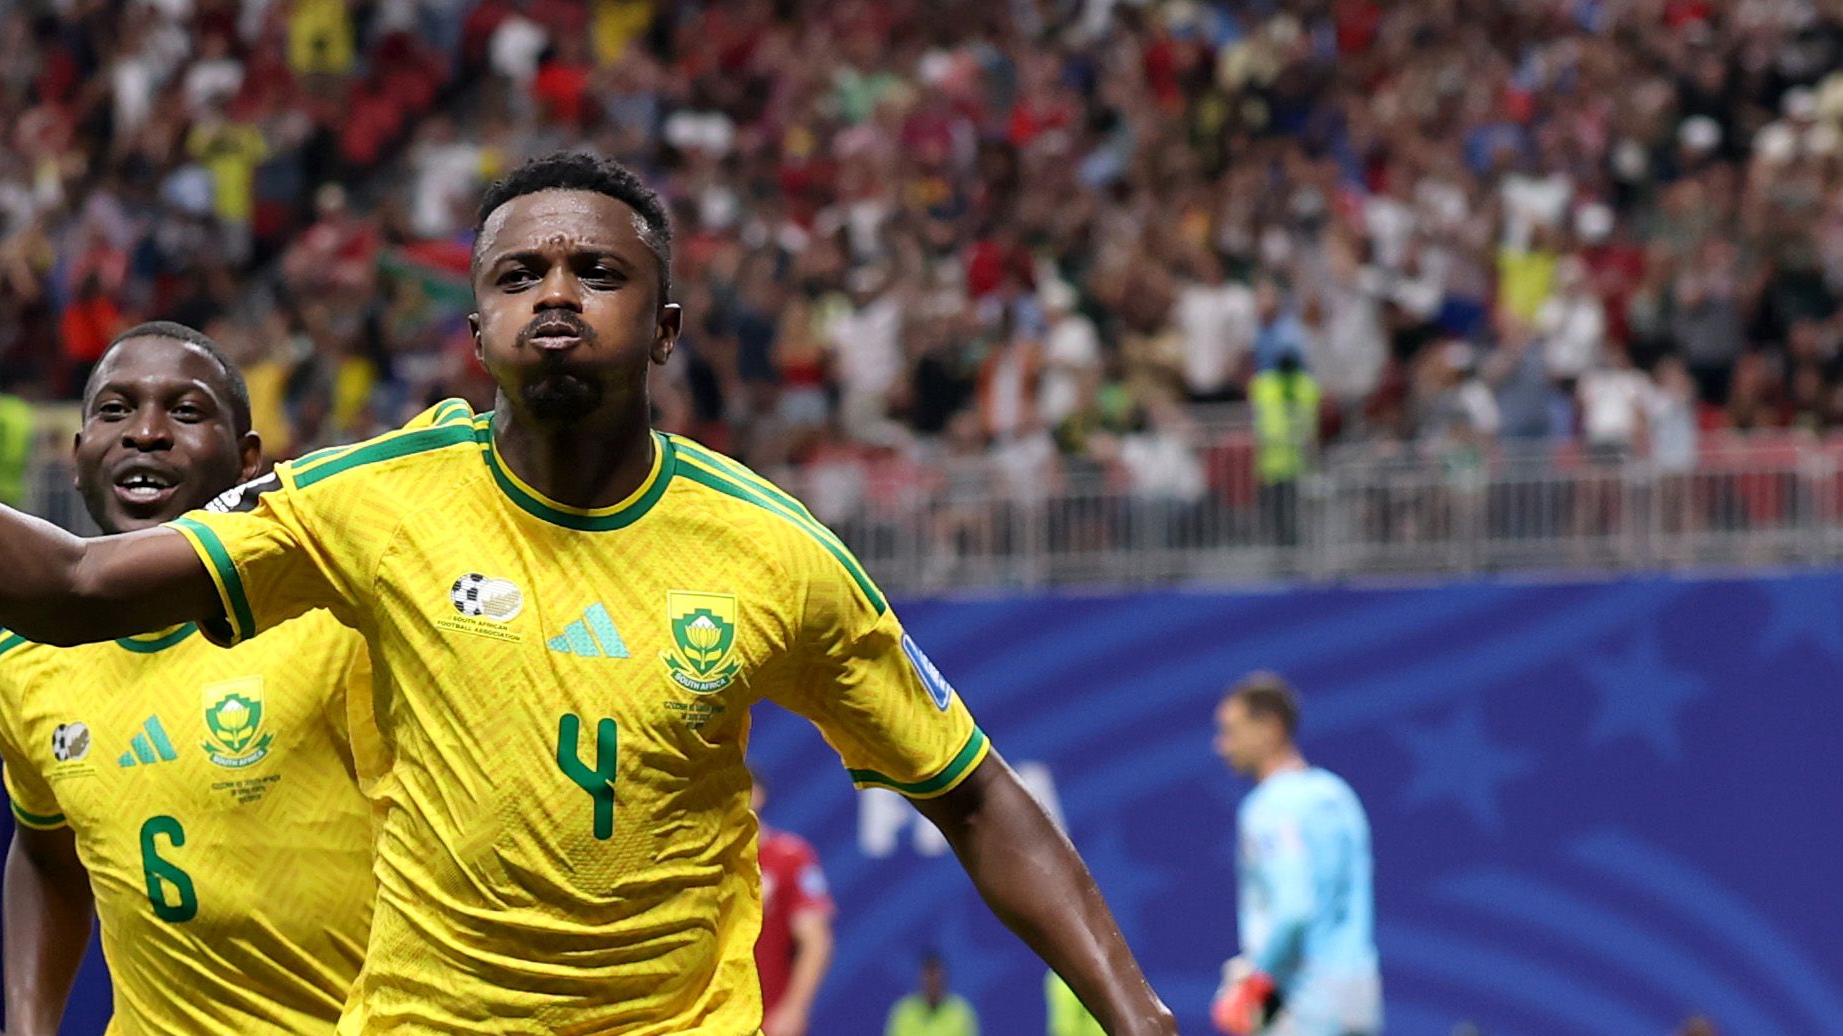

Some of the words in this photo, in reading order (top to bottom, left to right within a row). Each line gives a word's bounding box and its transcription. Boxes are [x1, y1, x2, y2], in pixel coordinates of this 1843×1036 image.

[437, 620, 471, 631] FOOTBALL
[474, 627, 521, 641] ASSOCIATION
[453, 615, 476, 625] SOUTH
[478, 621, 508, 631] AFRICAN
[675, 672, 699, 690] SOUTH
[700, 678, 727, 690] AFRICA
[558, 713, 617, 840] 4
[140, 815, 198, 923] 6
